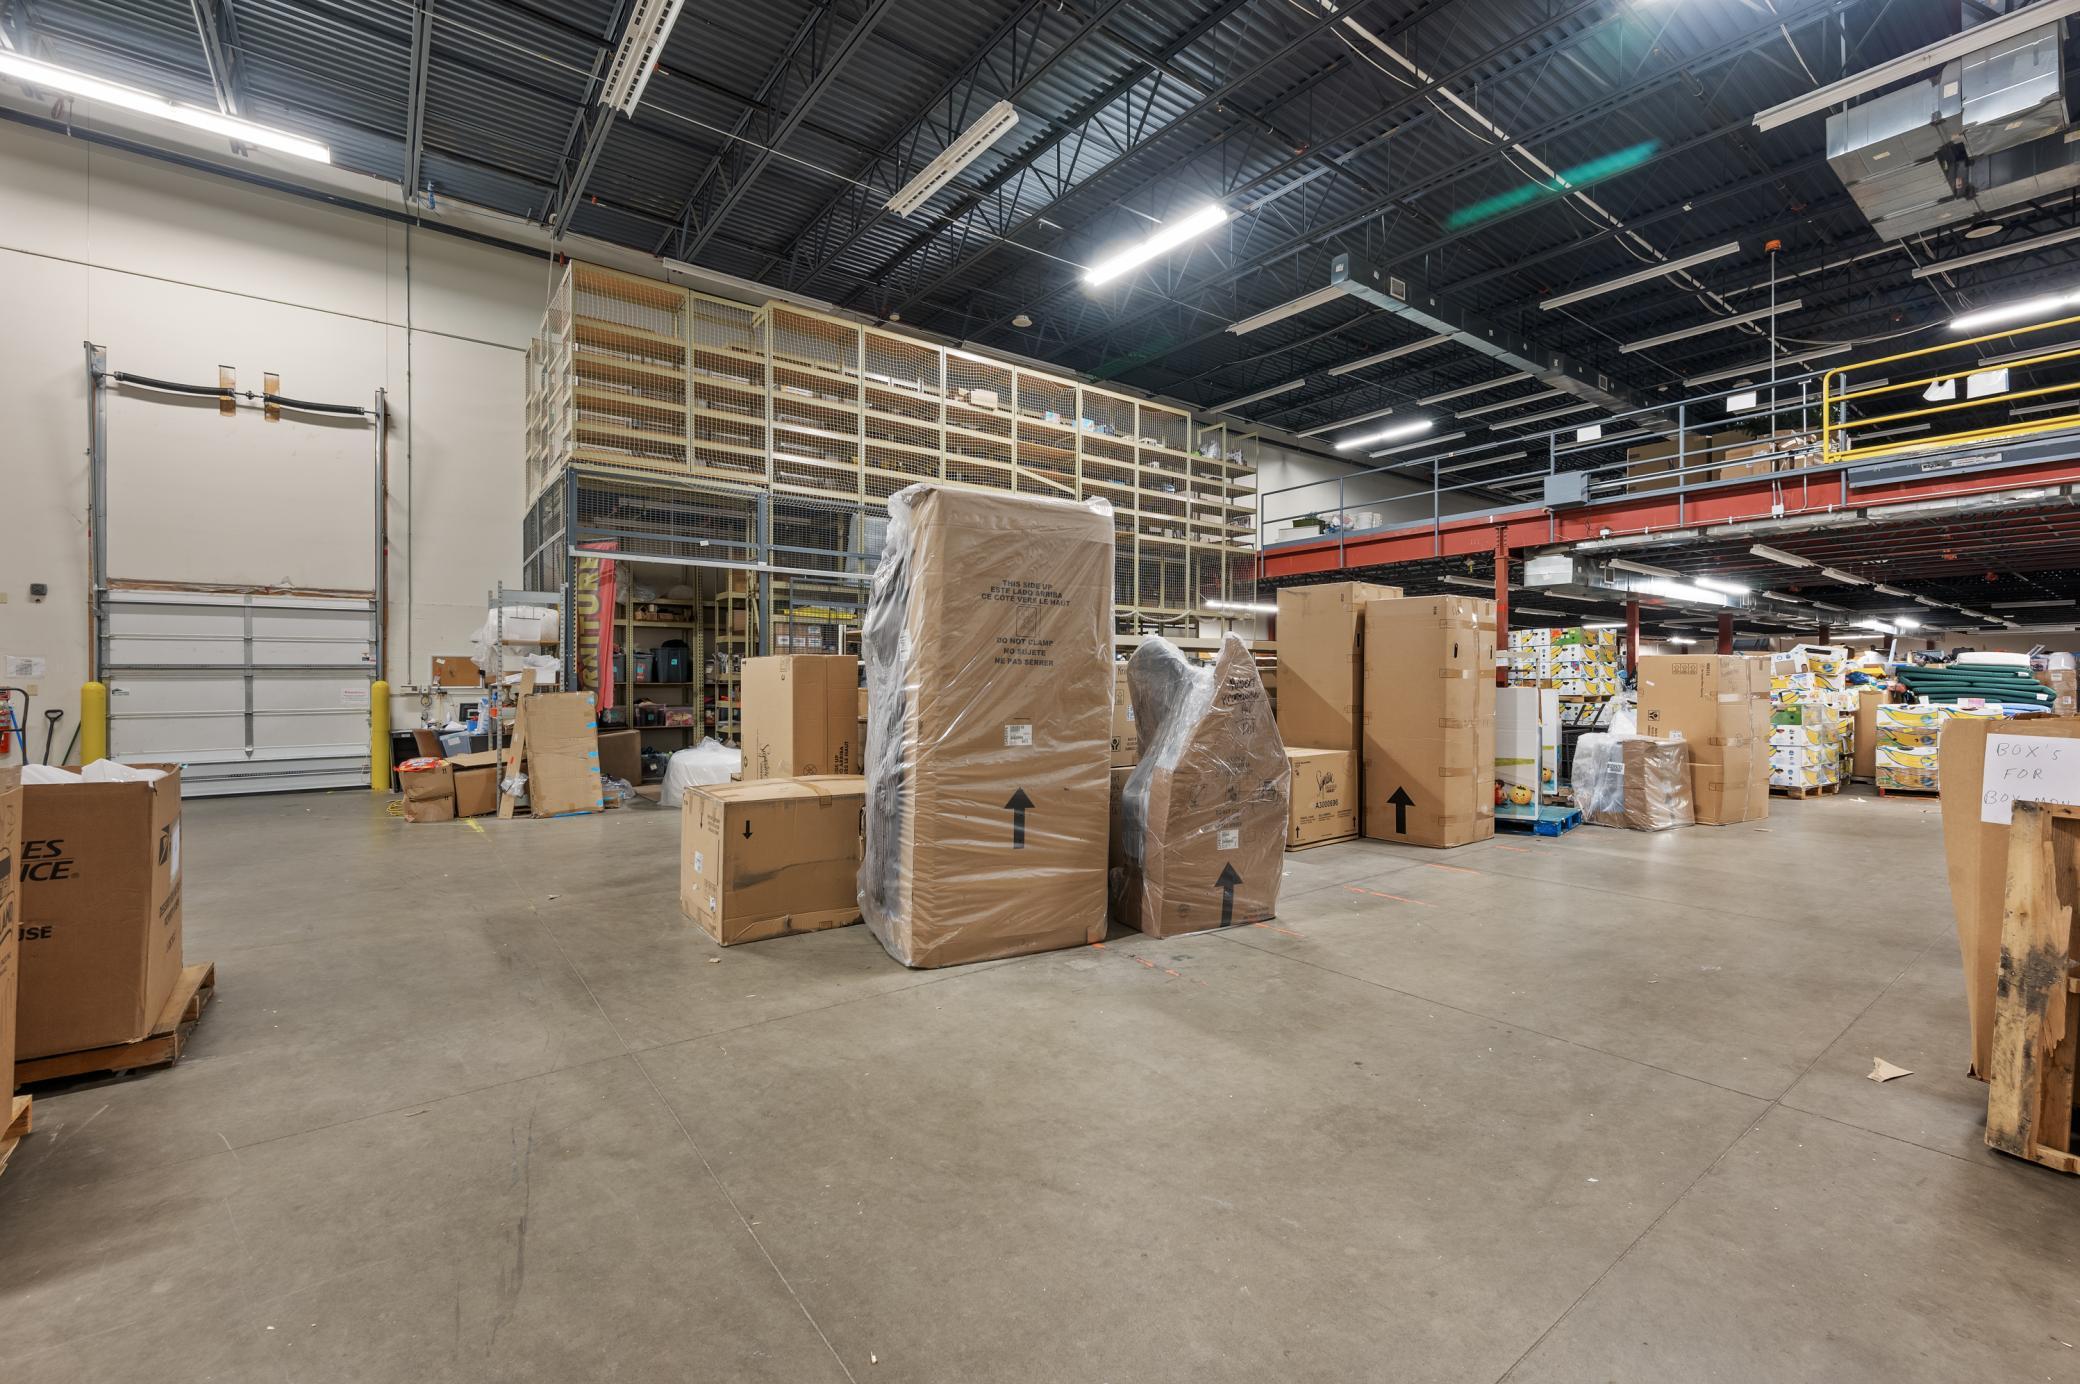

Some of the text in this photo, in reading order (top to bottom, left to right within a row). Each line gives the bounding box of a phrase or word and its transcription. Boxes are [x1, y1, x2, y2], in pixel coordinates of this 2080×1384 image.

[1013, 588, 1033, 596] LADO
[1035, 591, 1063, 599] ARRIBA
[578, 557, 600, 688] RNITURE
[997, 637, 1008, 645] DO
[1028, 639, 1054, 647] CLAMP
[1017, 648, 1046, 656] SUJETE
[995, 657, 1005, 665] NE
[2003, 768, 2043, 780] FOR
